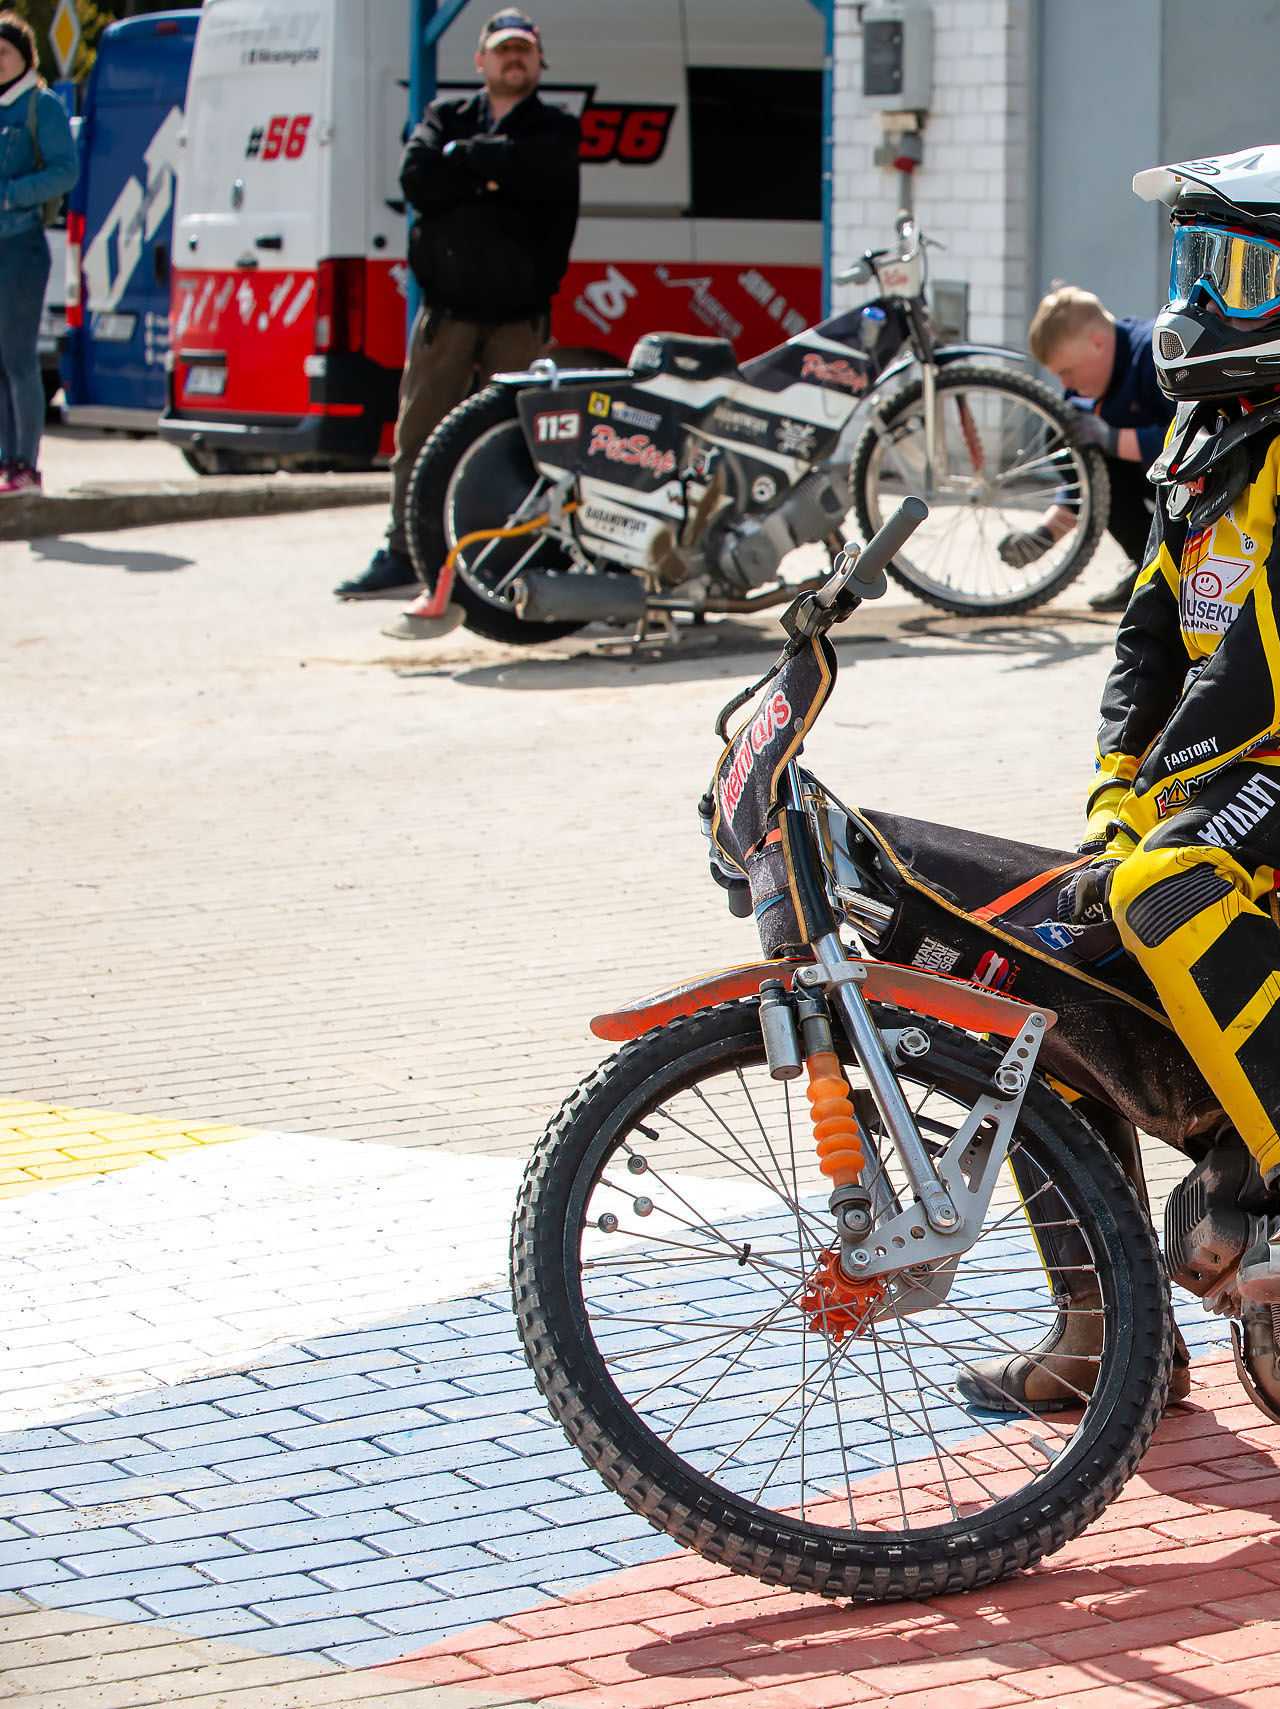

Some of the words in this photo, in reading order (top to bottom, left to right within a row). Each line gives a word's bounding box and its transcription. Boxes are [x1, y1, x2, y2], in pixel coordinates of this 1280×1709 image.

[245, 114, 313, 161] #56
[579, 110, 668, 159] 56
[537, 412, 581, 442] 113
[587, 424, 677, 479] PitStop
[1184, 619, 1219, 632] ANNO
[1163, 736, 1219, 772] FACTORY
[911, 936, 937, 969] MALI
